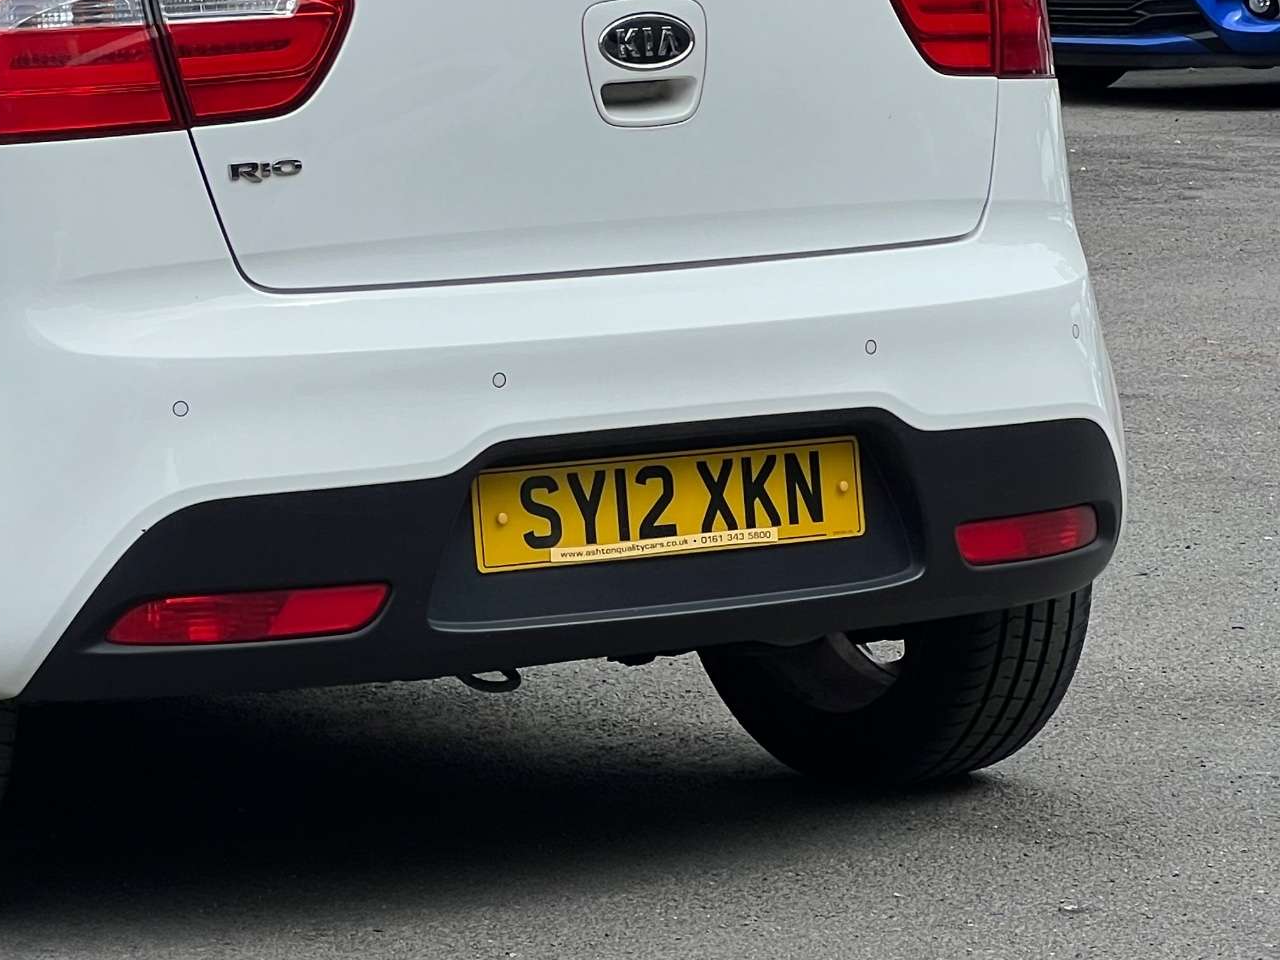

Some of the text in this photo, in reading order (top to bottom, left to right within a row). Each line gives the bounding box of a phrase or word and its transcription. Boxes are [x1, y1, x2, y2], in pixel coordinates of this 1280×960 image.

[616, 26, 680, 58] KIA
[520, 450, 825, 550] SY12 XKN
[560, 538, 689, 559] www.ashtonqualitycars.co.uk
[700, 535, 723, 545] 0161
[727, 532, 745, 542] 343
